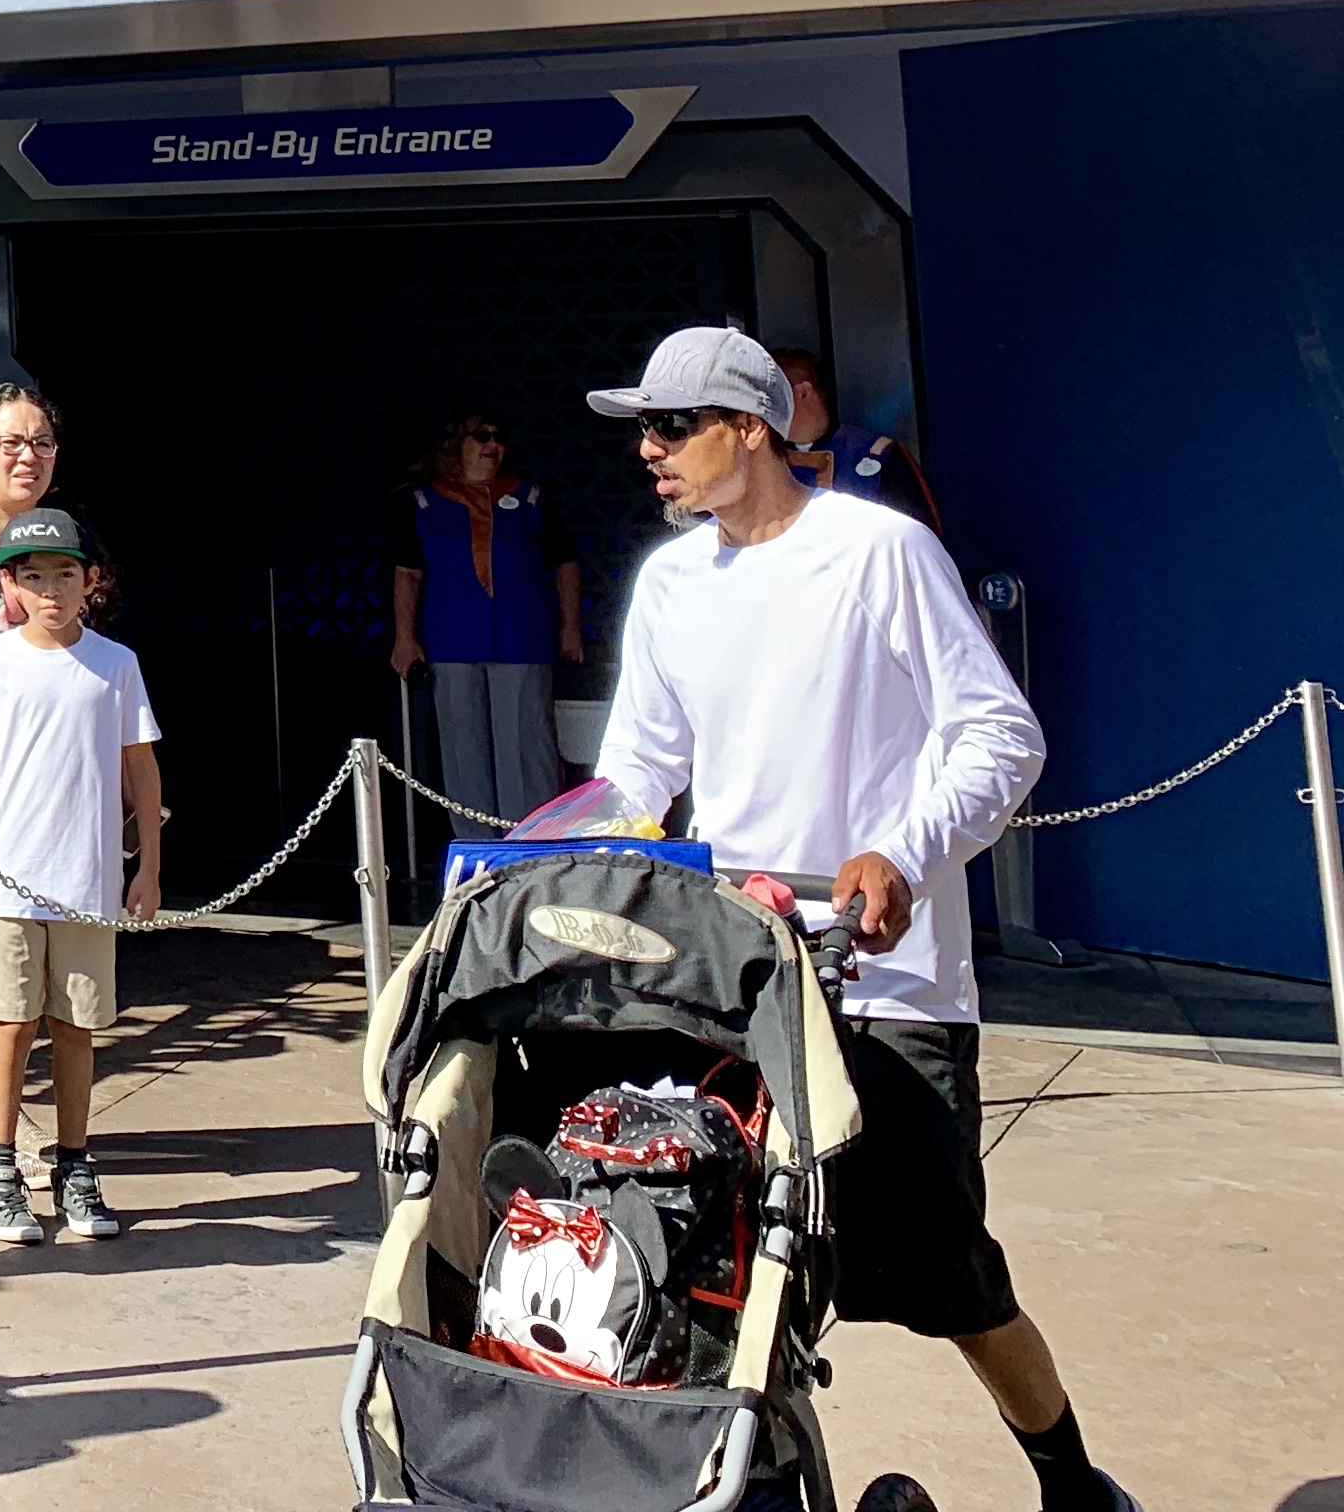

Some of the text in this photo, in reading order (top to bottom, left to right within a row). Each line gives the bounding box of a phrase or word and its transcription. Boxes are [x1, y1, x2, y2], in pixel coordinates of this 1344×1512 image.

[152, 126, 493, 166] Stand-By Entrance
[10, 523, 61, 541] RVCA
